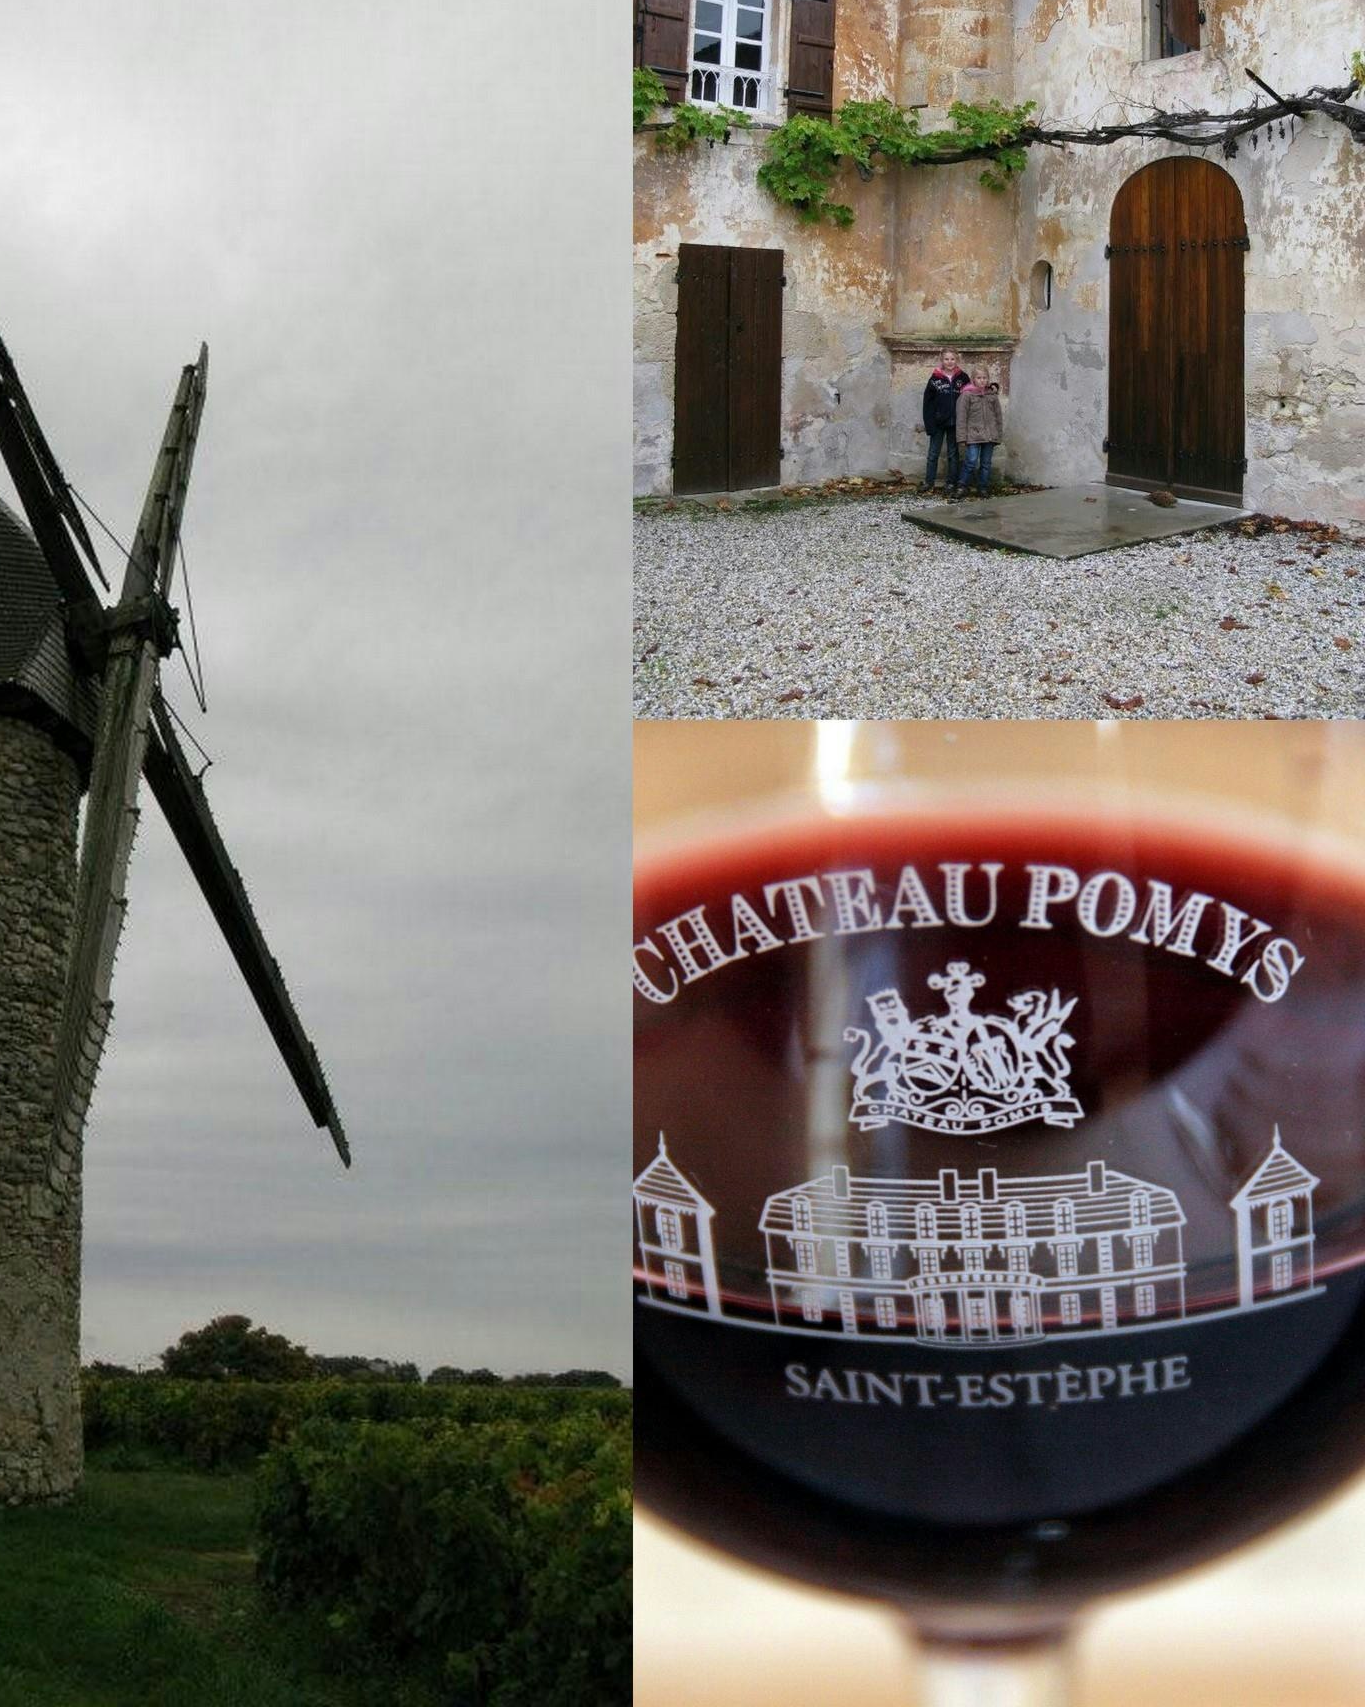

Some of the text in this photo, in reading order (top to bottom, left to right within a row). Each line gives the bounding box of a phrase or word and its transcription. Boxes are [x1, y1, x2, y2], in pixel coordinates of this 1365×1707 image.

[633, 862, 1306, 1005] CHATEAU POMYS
[868, 1102, 1053, 1132] CHATEAU POMYS
[784, 1355, 1192, 1409] SAINT-ESTÈPHE
